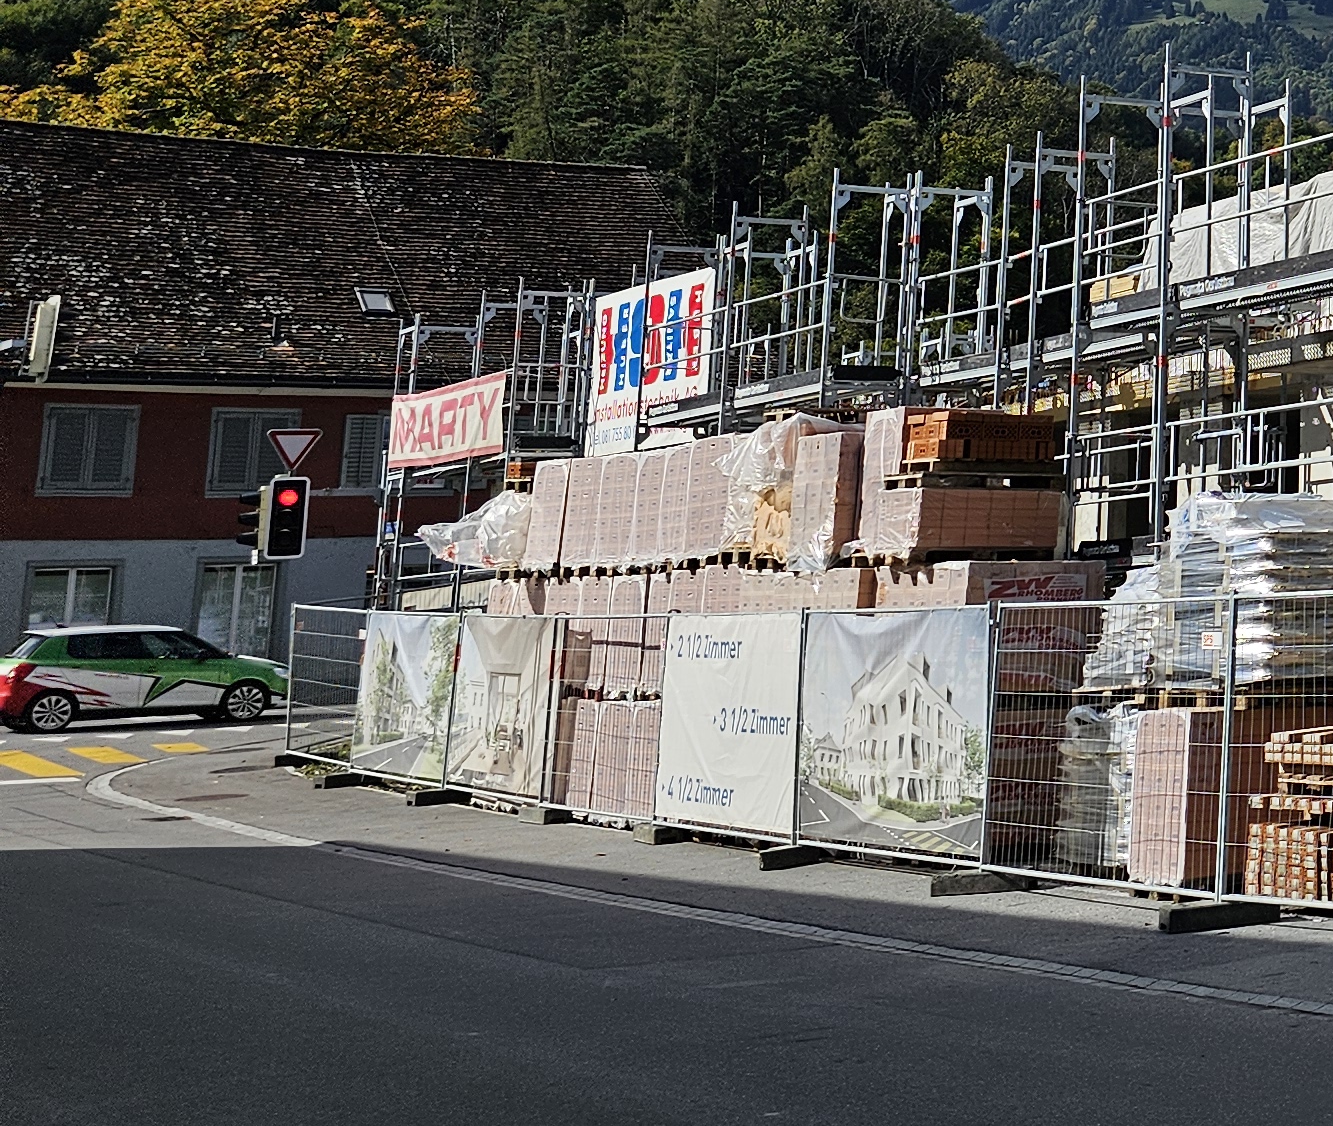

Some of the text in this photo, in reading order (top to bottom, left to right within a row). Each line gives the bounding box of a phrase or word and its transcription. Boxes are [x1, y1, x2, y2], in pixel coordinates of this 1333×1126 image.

[391, 387, 501, 455] MARTY
[1017, 587, 1084, 599] RHOMBERG
[677, 632, 743, 661] 2 1/2 Zimmer
[719, 705, 792, 736] 3 1/2 Zimmer
[667, 774, 735, 808] 4 1/2 Zimmer
